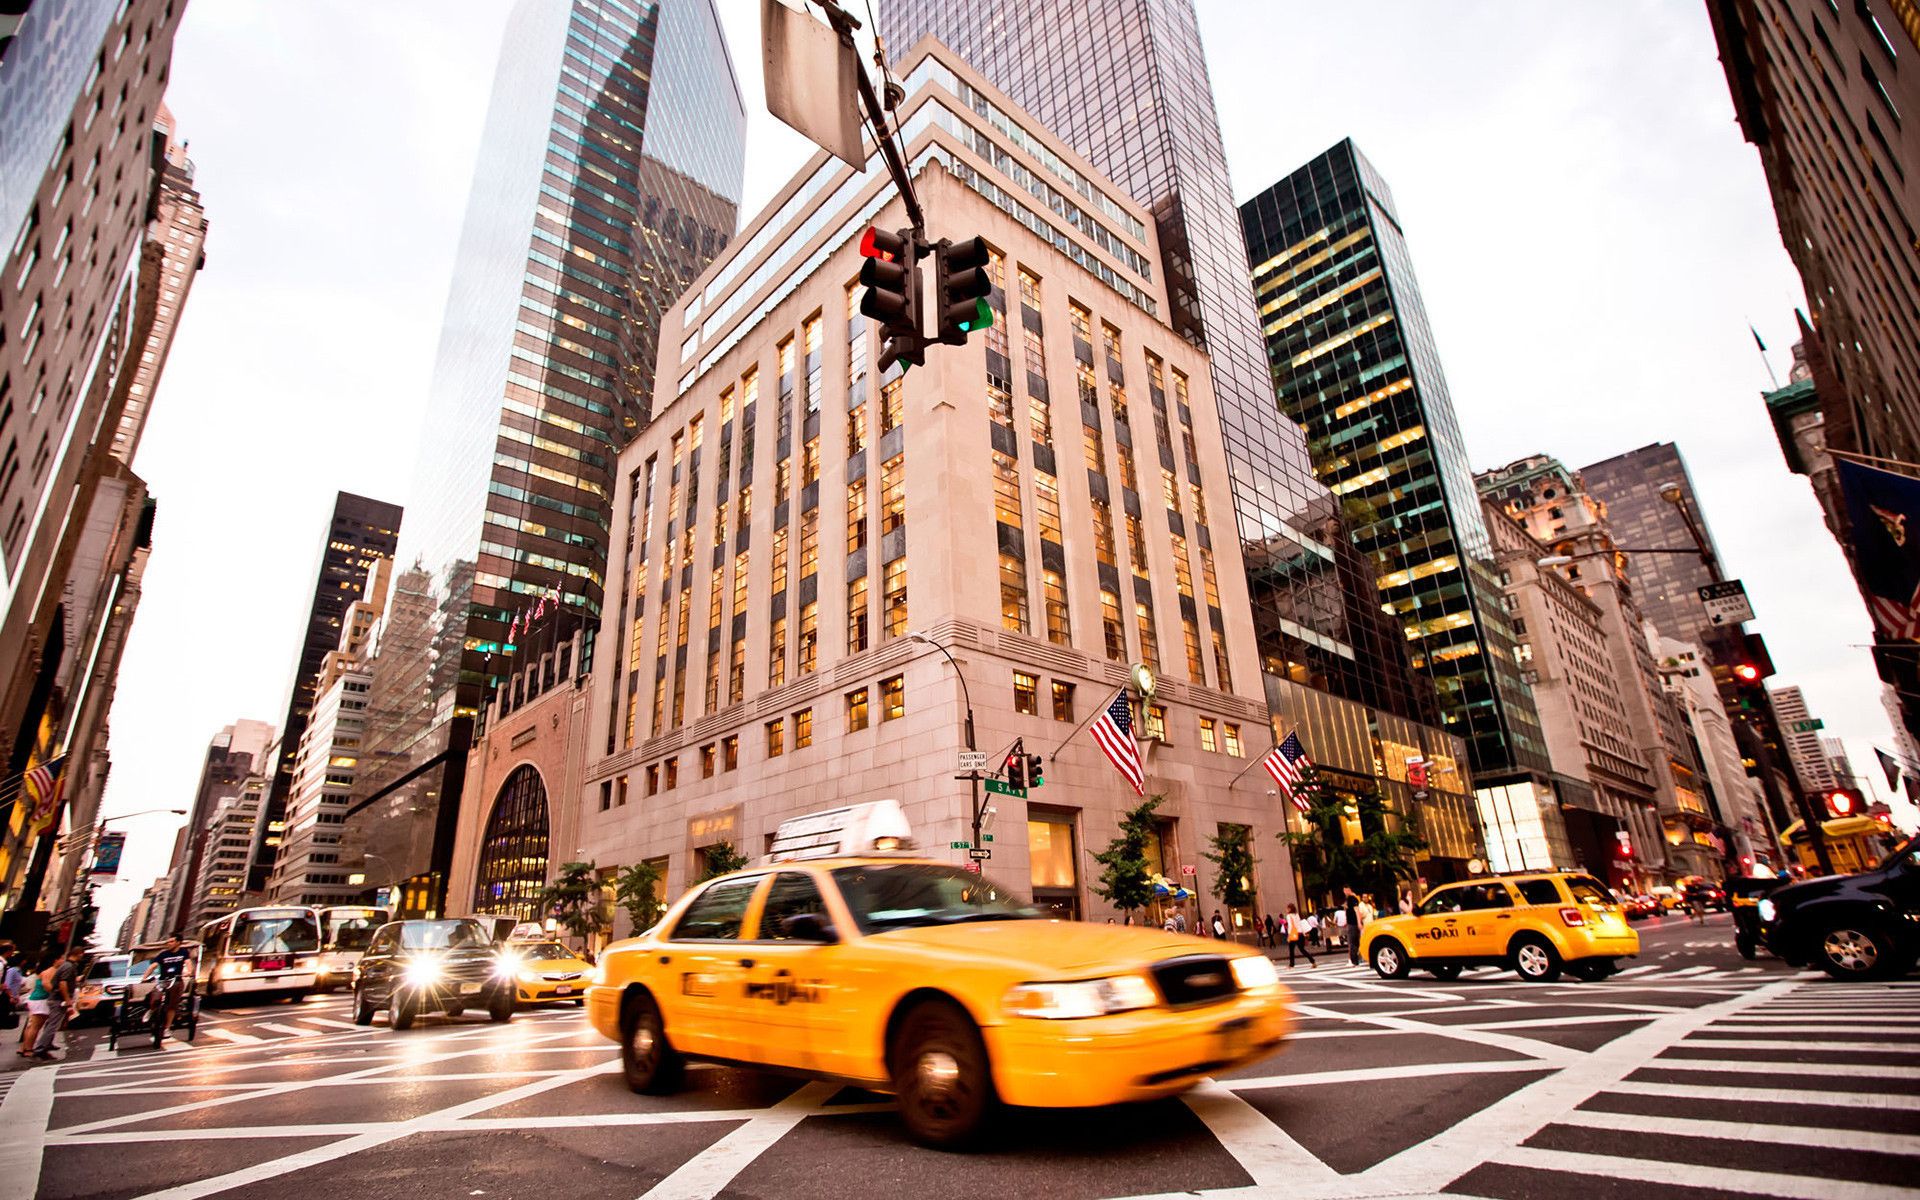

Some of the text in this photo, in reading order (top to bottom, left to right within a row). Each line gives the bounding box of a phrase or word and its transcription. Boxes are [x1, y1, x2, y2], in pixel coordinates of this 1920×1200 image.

[1710, 596, 1741, 607] BUSES
[1721, 603, 1745, 613] ONLY
[1430, 927, 1459, 940] TAXI
